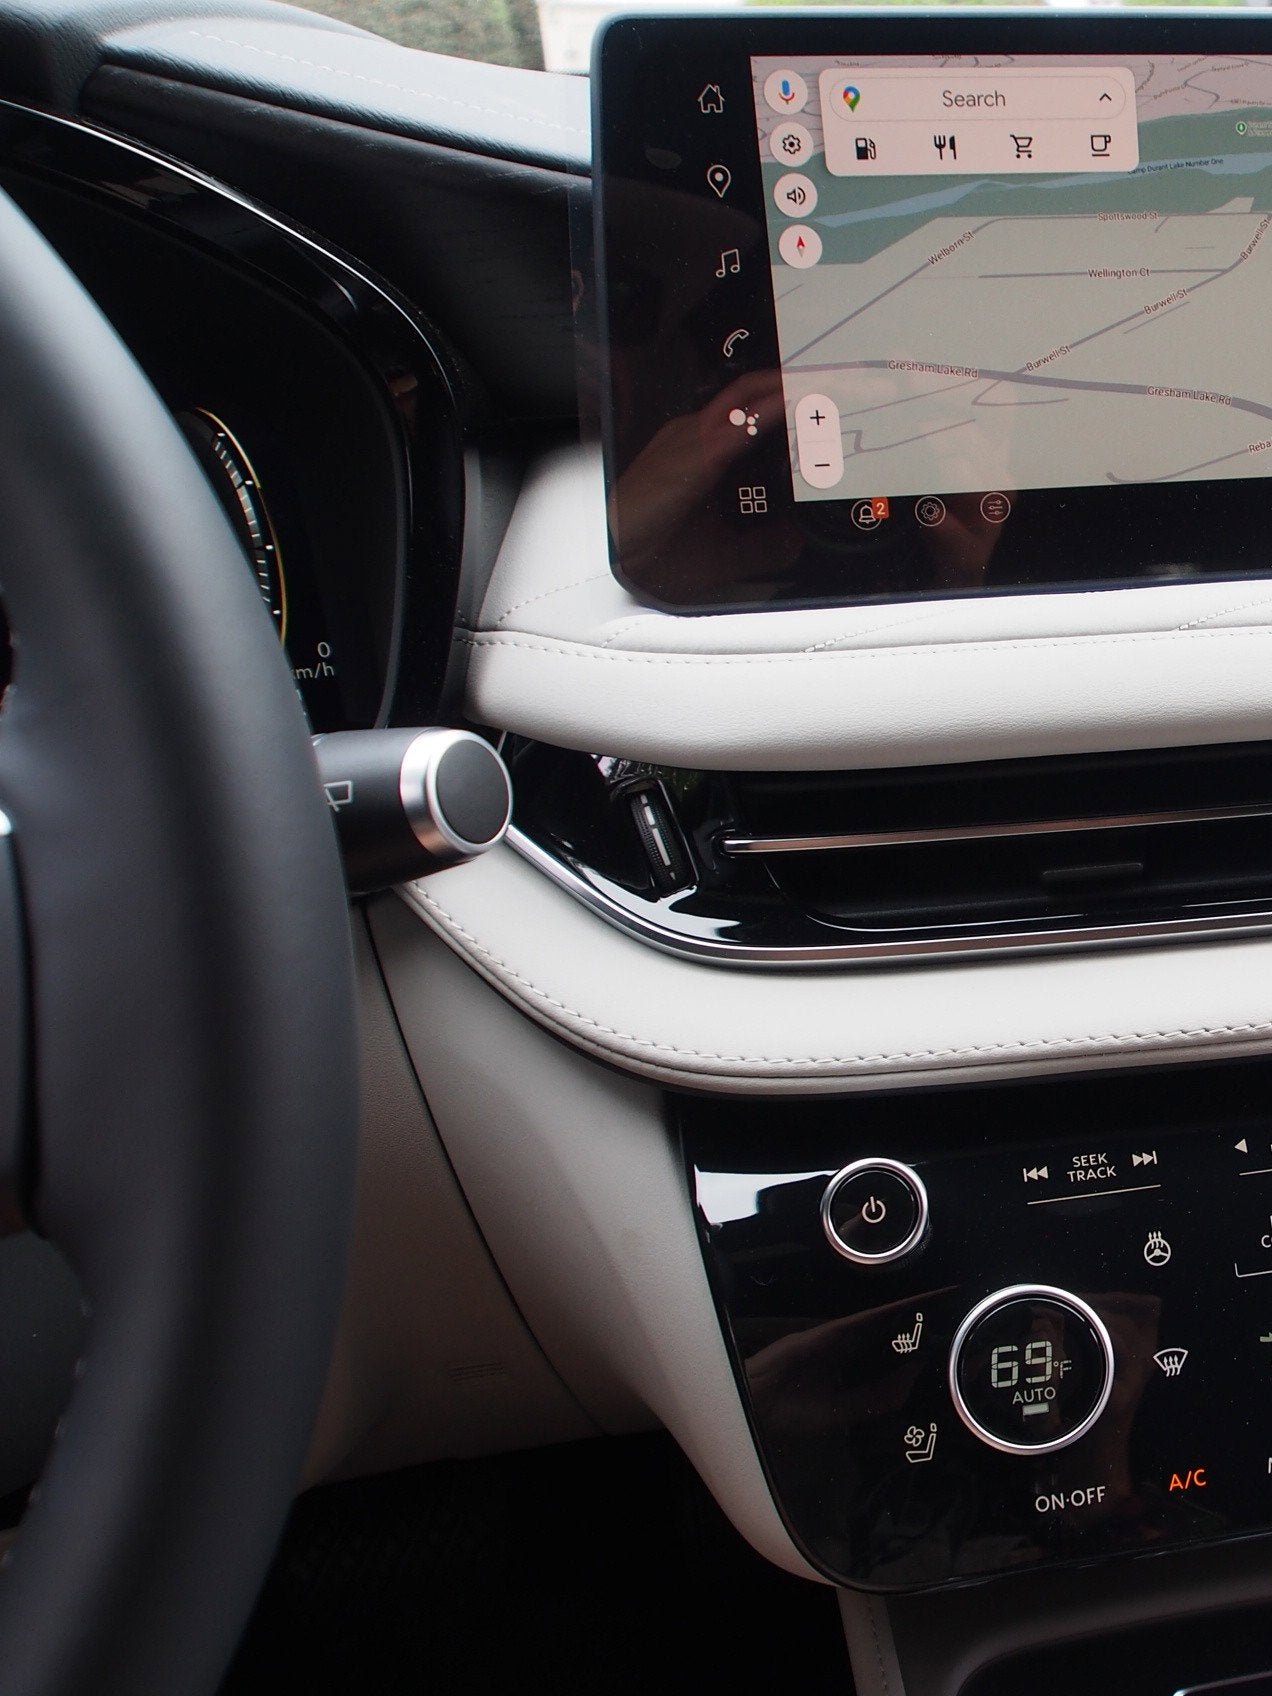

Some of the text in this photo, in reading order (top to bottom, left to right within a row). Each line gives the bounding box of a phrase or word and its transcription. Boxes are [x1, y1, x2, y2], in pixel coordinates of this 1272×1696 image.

[942, 89, 1006, 108] Search
[1147, 164, 1169, 172] Durant
[1169, 162, 1185, 170] Lake
[1185, 159, 1210, 168] Number
[1099, 212, 1158, 222] Spottswood St
[928, 231, 974, 265] Welborn St
[1088, 267, 1150, 279] Wellington Ct
[1144, 288, 1188, 315] Burwell St
[1025, 345, 1071, 372] Burwell St
[888, 360, 978, 378] Gresham Lake Rd
[1147, 386, 1232, 405] Gresham Lake Rd
[1248, 441, 1272, 453] Reba
[876, 502, 886, 515] 2
[317, 641, 330, 658] 0
[291, 661, 335, 679] m/h
[1072, 1152, 1108, 1168] SEEK
[1067, 1165, 1117, 1182] TRACK
[990, 1340, 1053, 1389] 69
[1012, 1386, 1057, 1405] AUTO
[1169, 1469, 1207, 1492] A/C
